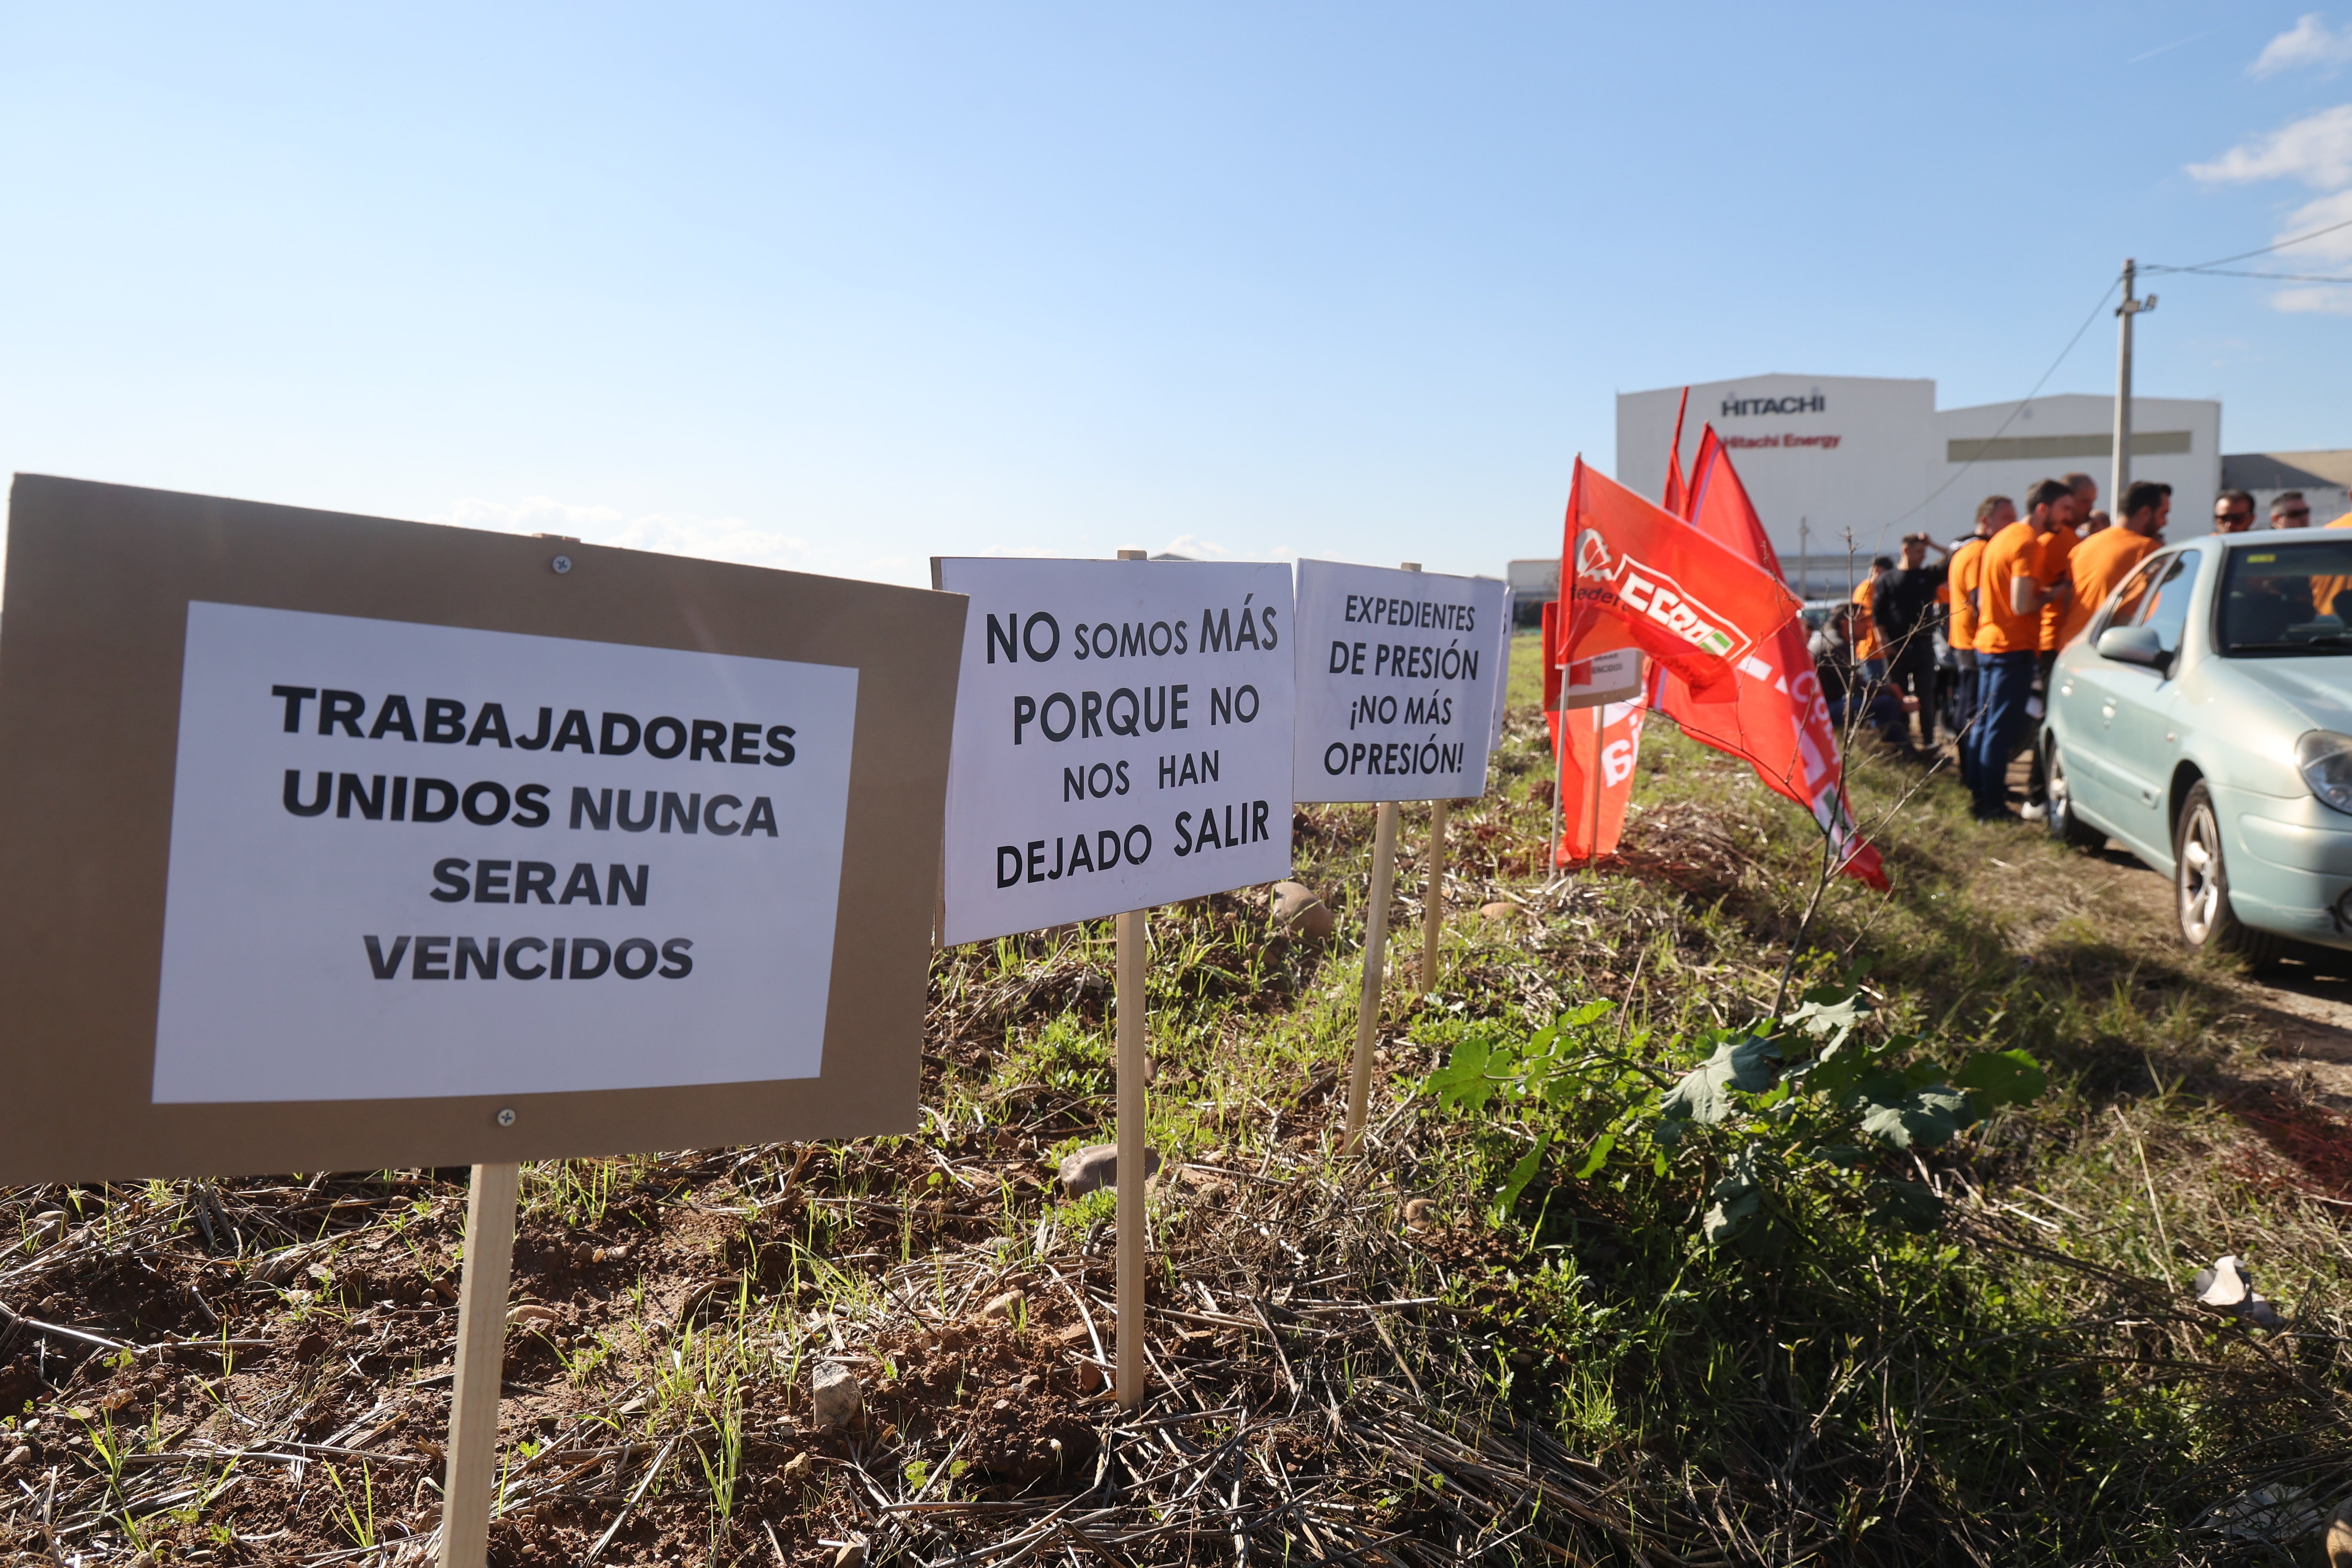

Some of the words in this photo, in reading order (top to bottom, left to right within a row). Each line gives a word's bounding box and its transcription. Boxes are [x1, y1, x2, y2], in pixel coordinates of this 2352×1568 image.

[1722, 395, 1825, 416] HITACHI
[1723, 434, 1779, 448] Hitachi
[1783, 434, 1842, 449] Energy
[987, 612, 1060, 664] NO
[1074, 621, 1187, 660] SOMOS
[1200, 594, 1277, 653] MÁS
[1345, 595, 1475, 631] EXPEDIENTES
[1329, 641, 1366, 674] DE
[1375, 639, 1478, 680] PRESIÓN
[272, 685, 796, 767] TRABAJADORES
[1014, 684, 1188, 745] PORQUE
[1211, 685, 1259, 725] NO
[1351, 695, 1397, 730] ¡NO
[1404, 689, 1452, 725] MÁS
[1064, 760, 1129, 802] NOS
[1160, 750, 1218, 789] HAN
[1324, 734, 1464, 775] OPRESIÓN!
[284, 770, 550, 827] UNIDOS
[570, 787, 778, 837] NUNCA
[998, 824, 1152, 888] DEJADO
[1174, 800, 1269, 856] SALIR
[430, 858, 649, 906] SERAN
[364, 936, 693, 980] VENCIDOS
